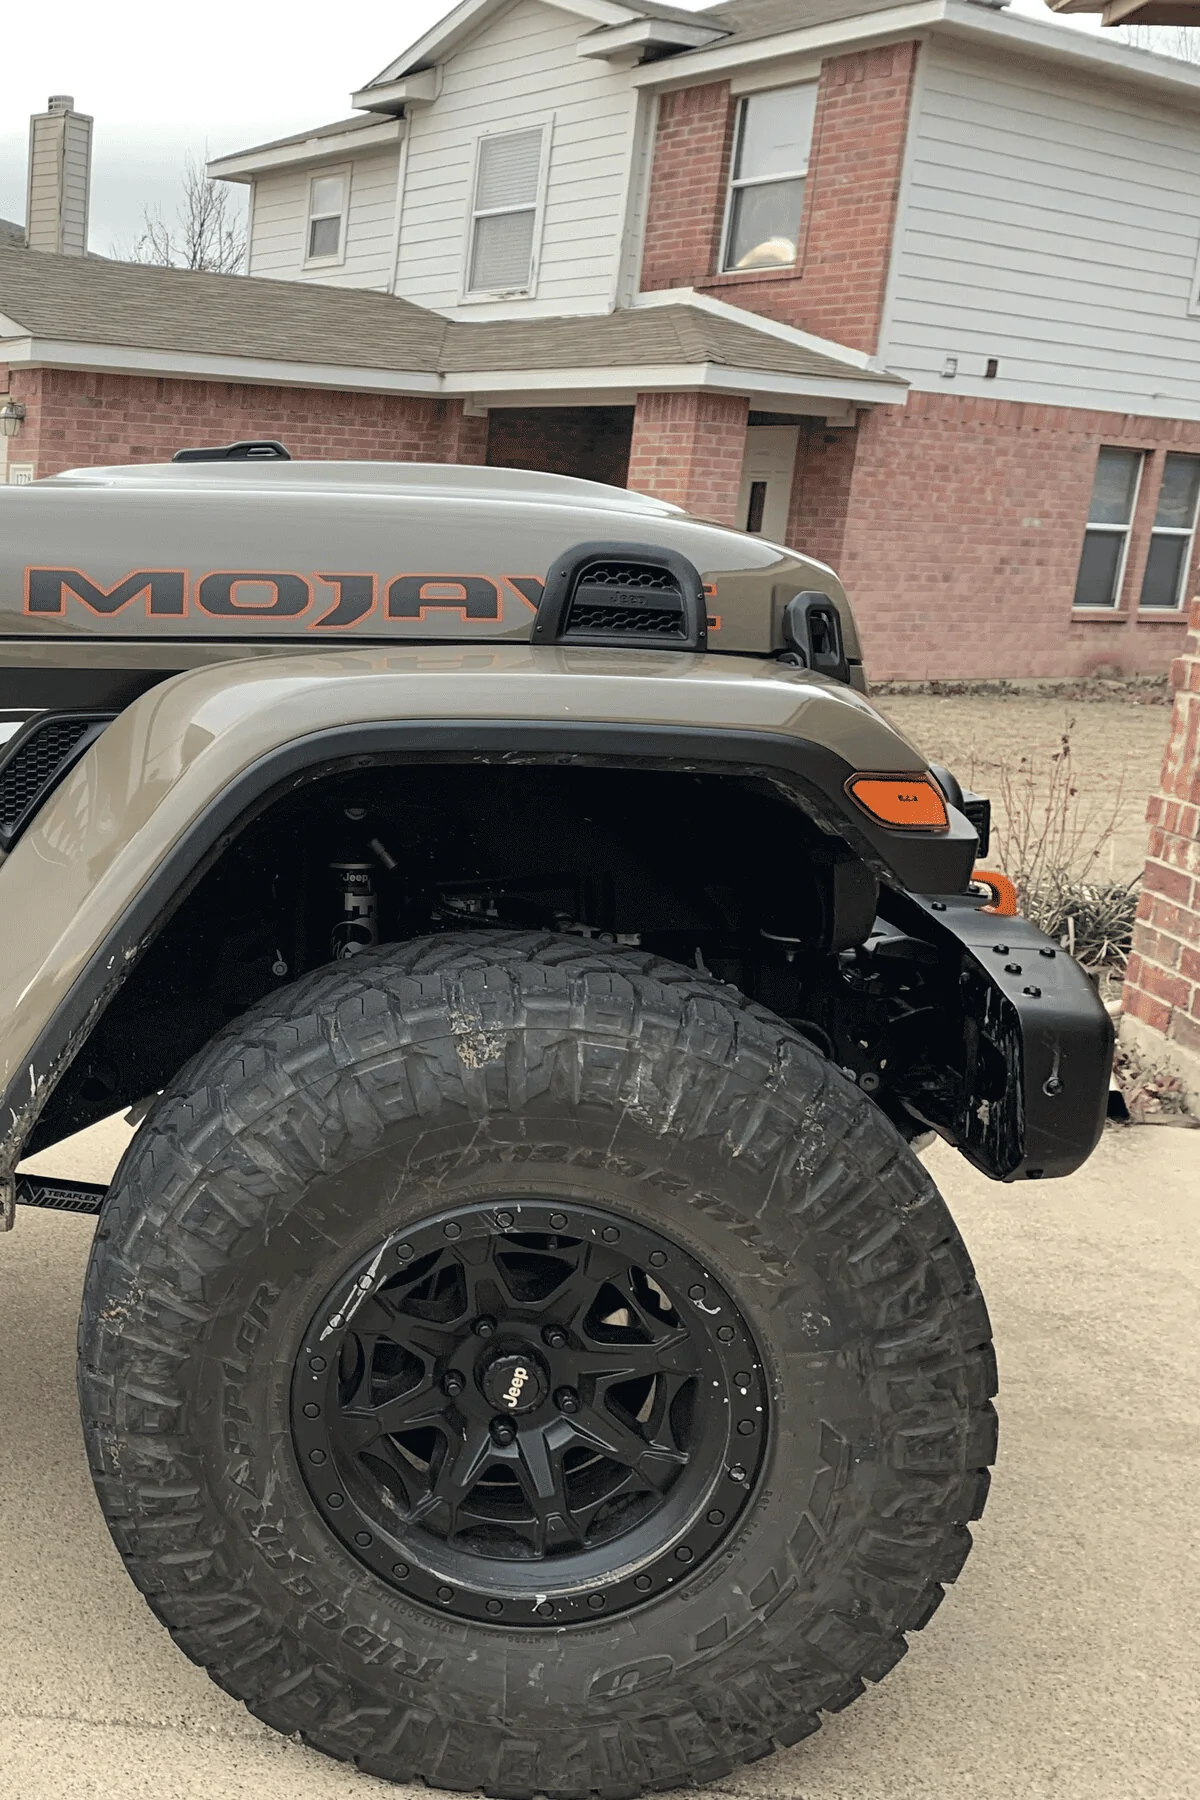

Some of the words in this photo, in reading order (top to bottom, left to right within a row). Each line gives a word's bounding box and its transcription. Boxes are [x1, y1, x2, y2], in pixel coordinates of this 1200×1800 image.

[24, 565, 721, 630] MOJA
[342, 872, 368, 883] Jeep
[48, 1190, 98, 1202] TERAFLEX
[502, 1367, 529, 1407] Jeep
